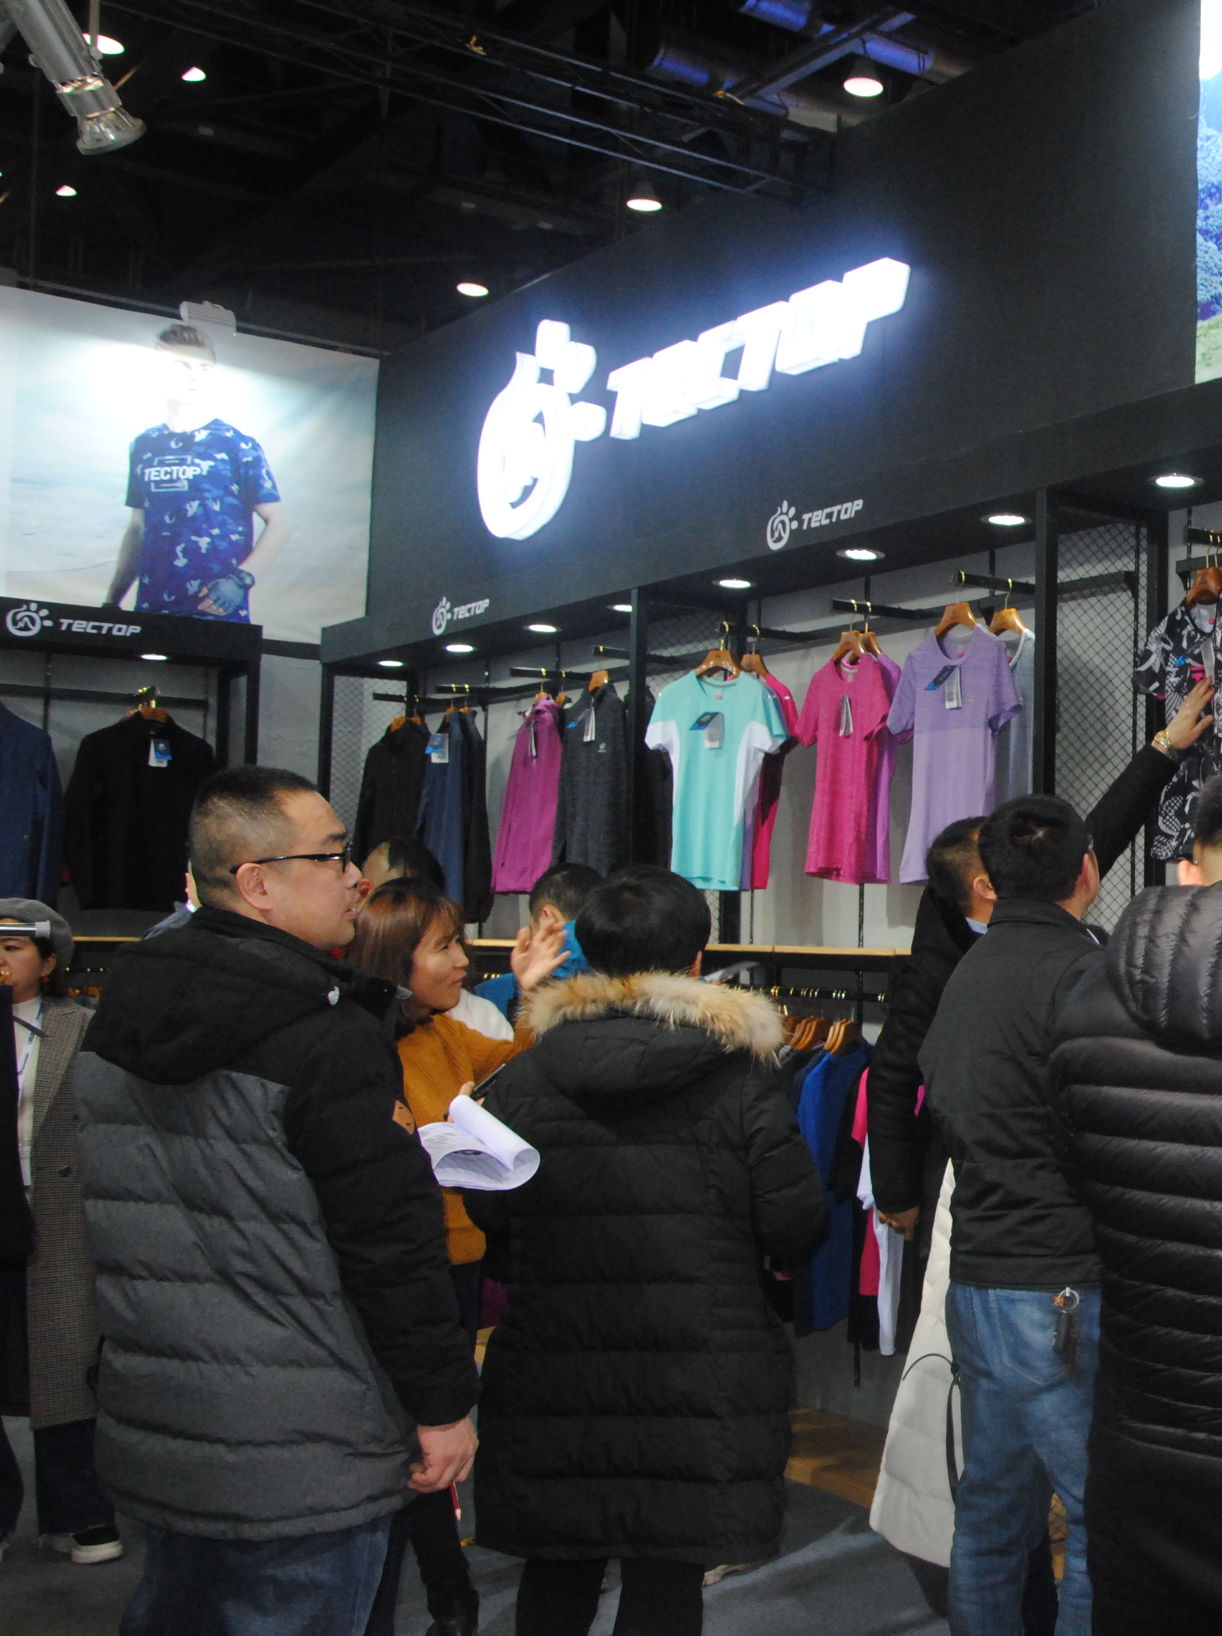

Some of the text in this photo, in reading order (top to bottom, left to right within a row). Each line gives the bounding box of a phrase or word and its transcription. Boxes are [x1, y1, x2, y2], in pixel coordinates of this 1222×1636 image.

[606, 257, 910, 440] TECTOP
[144, 465, 201, 481] TECTOP
[801, 499, 864, 530] TECTOP
[453, 598, 490, 620] TECTOP
[60, 618, 142, 637] TECTOP
